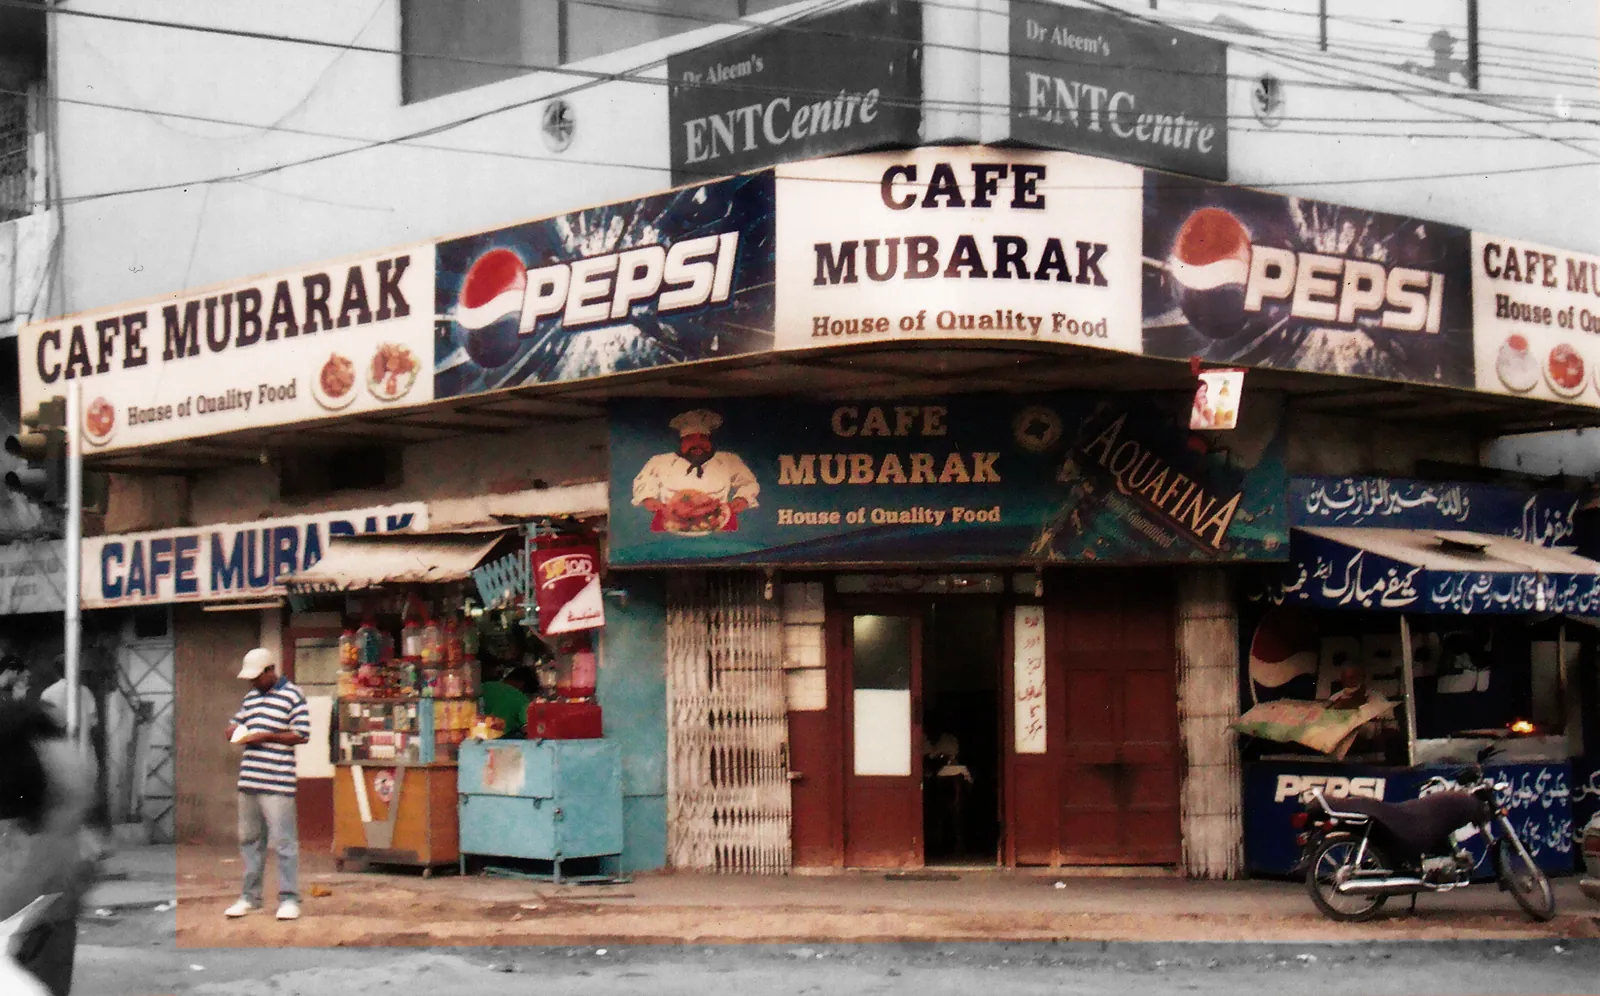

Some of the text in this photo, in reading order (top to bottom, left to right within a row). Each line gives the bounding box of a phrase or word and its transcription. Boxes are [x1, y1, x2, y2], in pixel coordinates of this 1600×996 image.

[1025, 18, 1111, 57] Dr Aleem's
[706, 54, 764, 85] Aleem's
[880, 162, 1046, 211] CAFE
[518, 230, 740, 336] PEPSI
[812, 234, 1109, 287] MUBARAK
[1483, 242, 1558, 289] CAFE
[1243, 244, 1446, 334] PEPSI
[1495, 293, 1553, 326] House
[1557, 306, 1575, 330] of
[37, 255, 412, 384] CAFE MUBARAK
[811, 310, 1108, 339] House of Quality Food
[127, 378, 297, 426] House of Quality Food
[831, 405, 949, 438] CAFE
[777, 452, 1001, 486] MUBARAK
[1083, 412, 1242, 550] AQUAFINA
[777, 505, 1001, 528] House of Quality Food
[100, 513, 415, 600] CAFE MUBA
[1274, 774, 1386, 803] PEPSI
